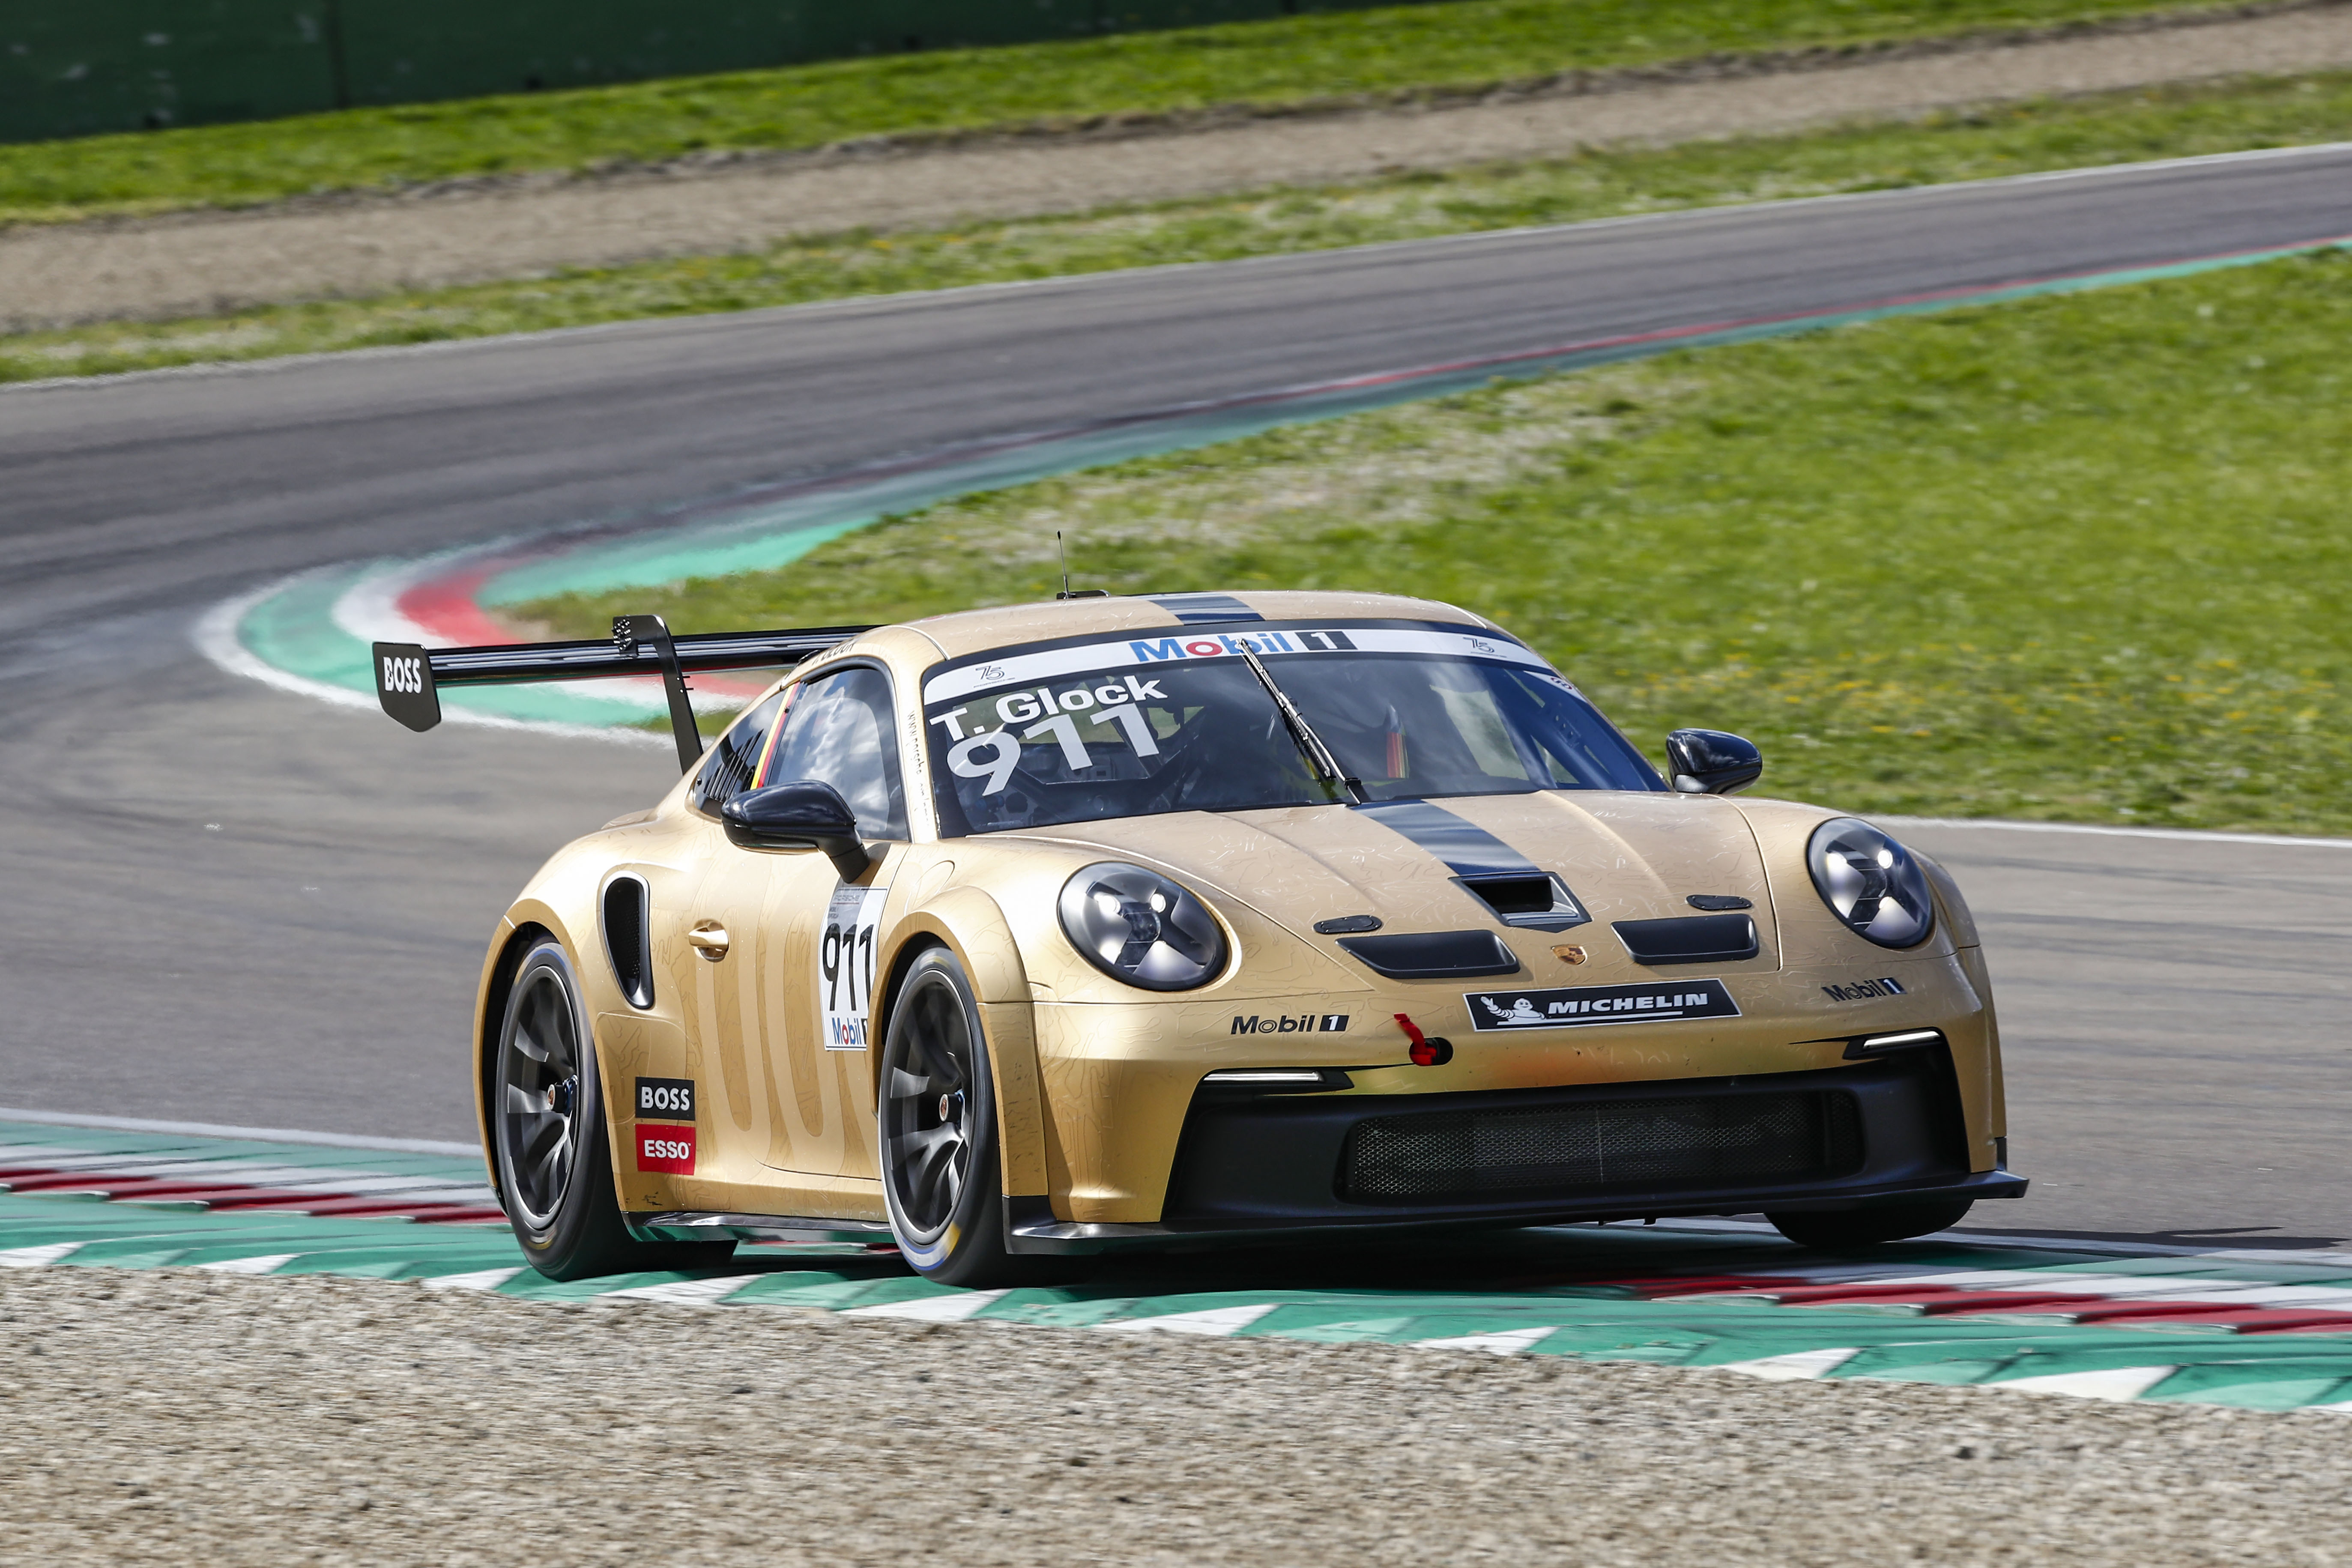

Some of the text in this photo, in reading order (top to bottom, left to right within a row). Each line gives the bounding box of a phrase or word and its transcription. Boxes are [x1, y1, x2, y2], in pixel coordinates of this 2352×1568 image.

[1128, 633, 1294, 662] Mobil
[383, 657, 422, 694] BOSS
[975, 666, 1004, 680] 75
[929, 675, 1168, 742] T. Glock
[947, 702, 1160, 796] 911
[822, 923, 874, 1011] 911
[1548, 993, 1708, 1014] MICHELIN
[1821, 980, 1887, 1002] Mobil
[832, 1017, 861, 1045] Mobil
[1231, 1015, 1315, 1034] Mobil
[642, 1087, 690, 1111] BOSS
[644, 1140, 690, 1159] ESSO
